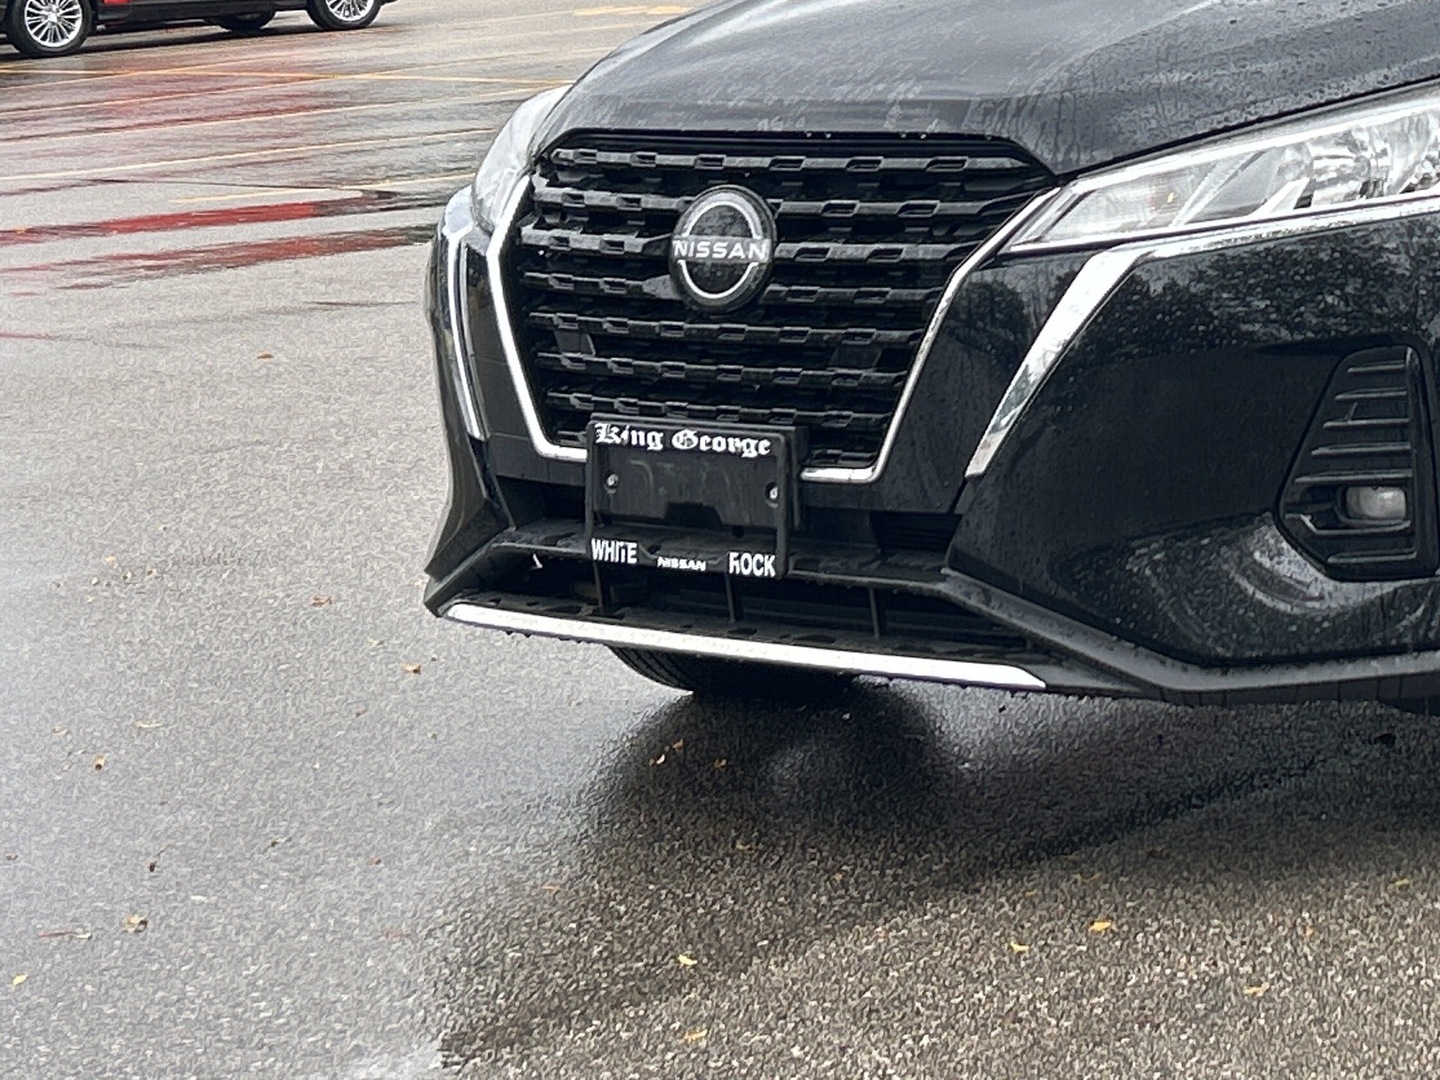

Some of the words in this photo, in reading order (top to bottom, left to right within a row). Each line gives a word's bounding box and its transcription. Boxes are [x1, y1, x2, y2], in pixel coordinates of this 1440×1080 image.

[672, 239, 767, 261] NISSAN
[594, 422, 664, 451] King
[671, 428, 771, 458] George
[591, 537, 638, 565] WHITE
[657, 556, 707, 571] NISSAN
[728, 551, 776, 578] ROCK
